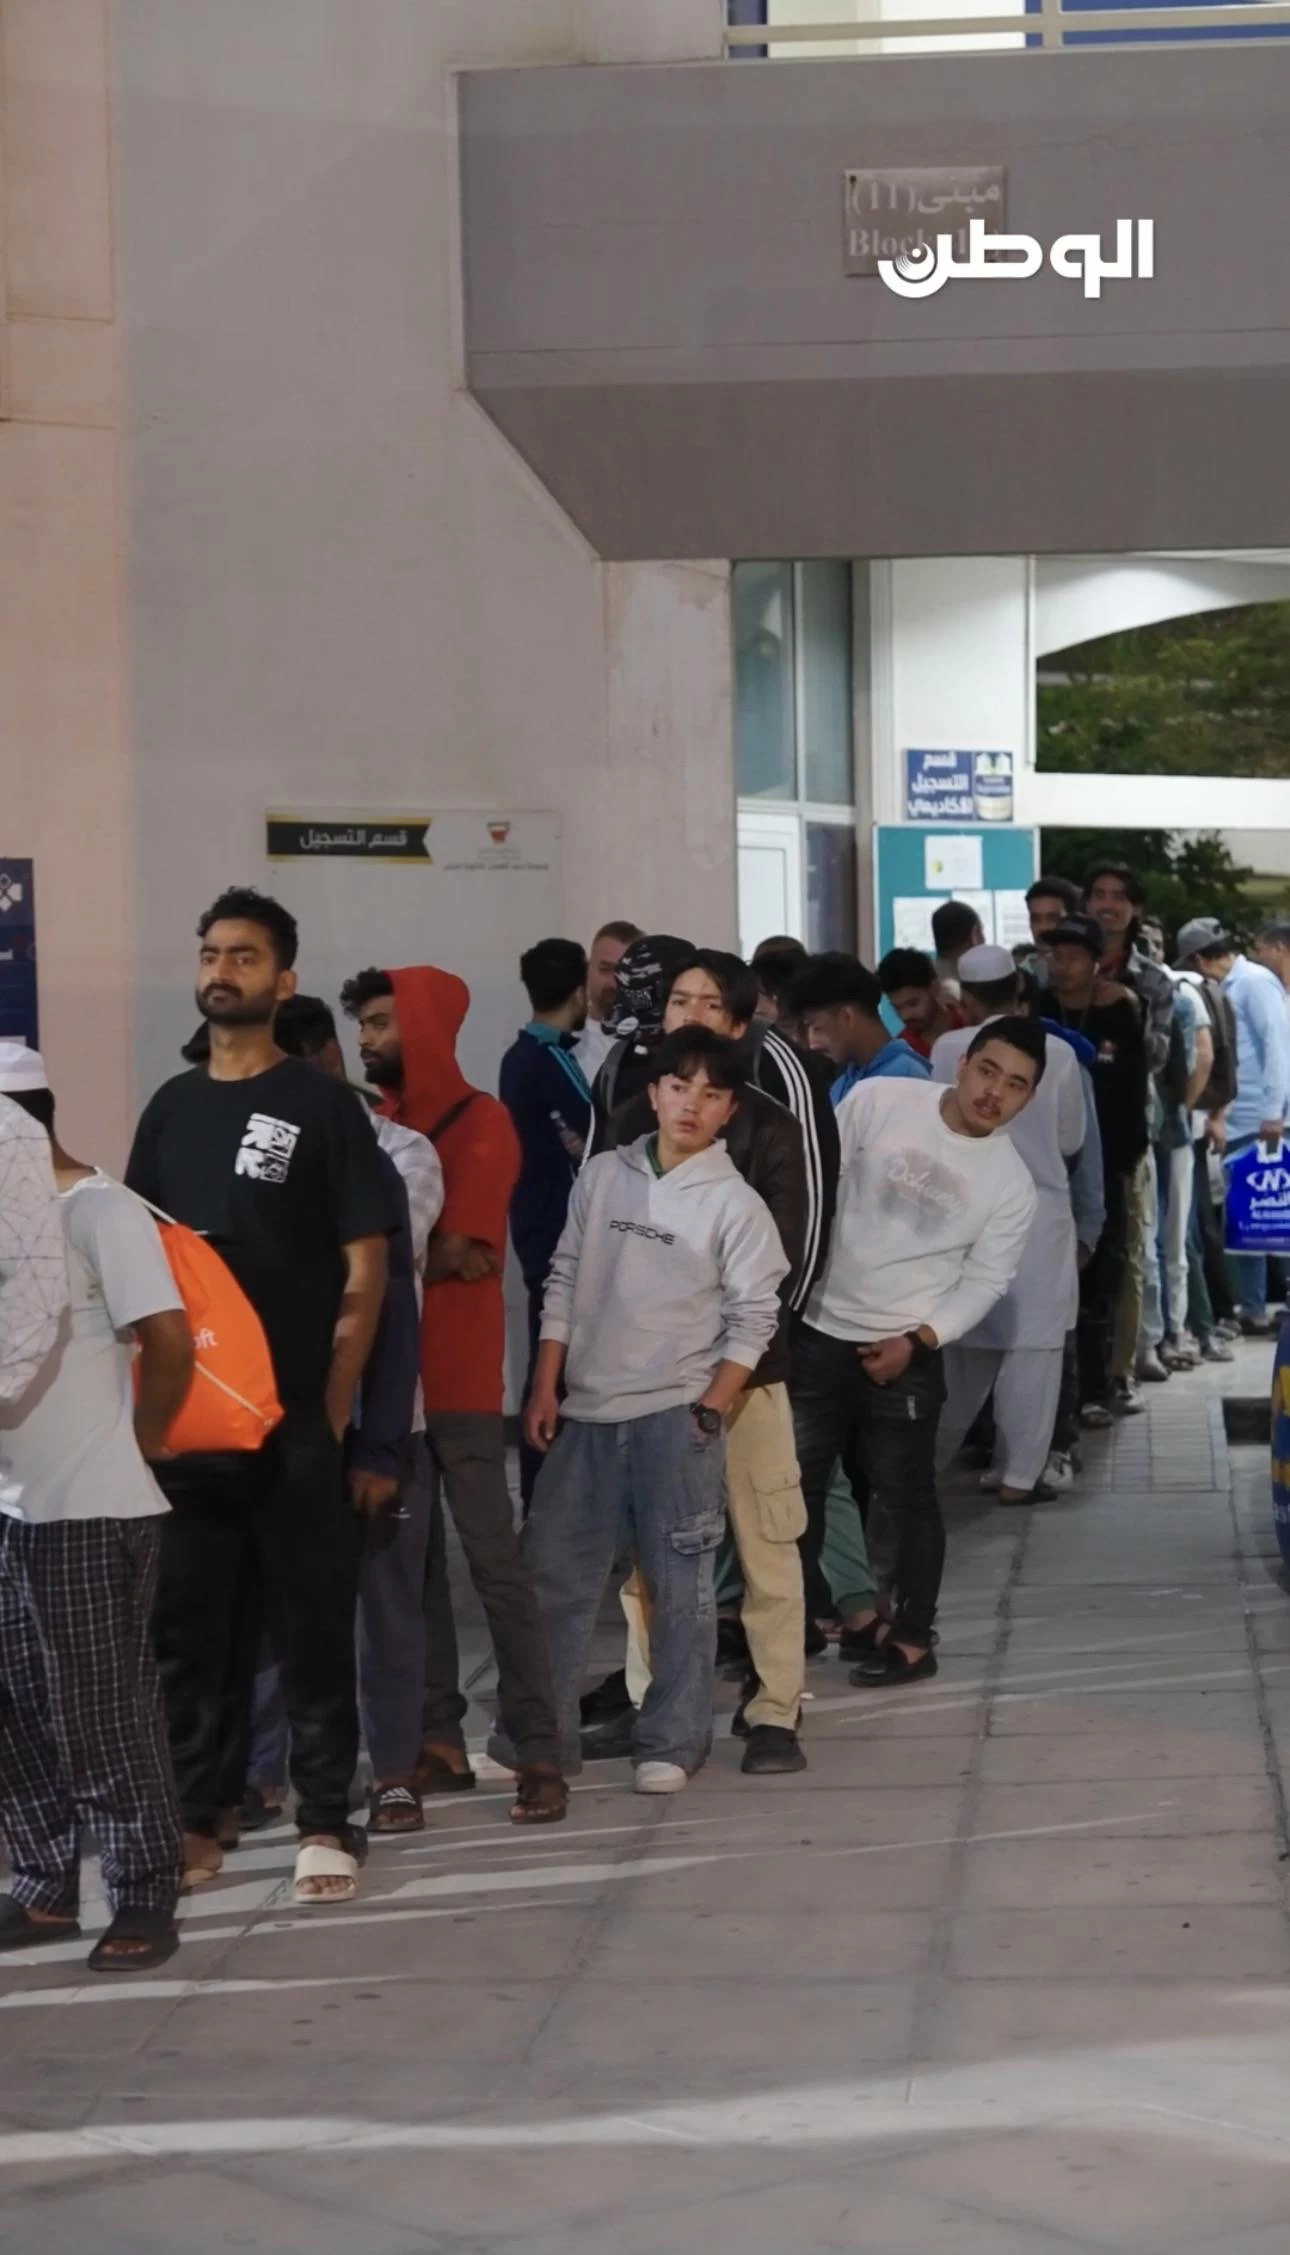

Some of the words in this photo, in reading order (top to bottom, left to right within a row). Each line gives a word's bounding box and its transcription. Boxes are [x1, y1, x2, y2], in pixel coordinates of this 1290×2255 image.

[911, 772, 969, 794] التسجيل
[299, 828, 367, 849] التسجيل
[368, 829, 408, 849] قسم
[608, 1219, 676, 1246] PORSCHE
